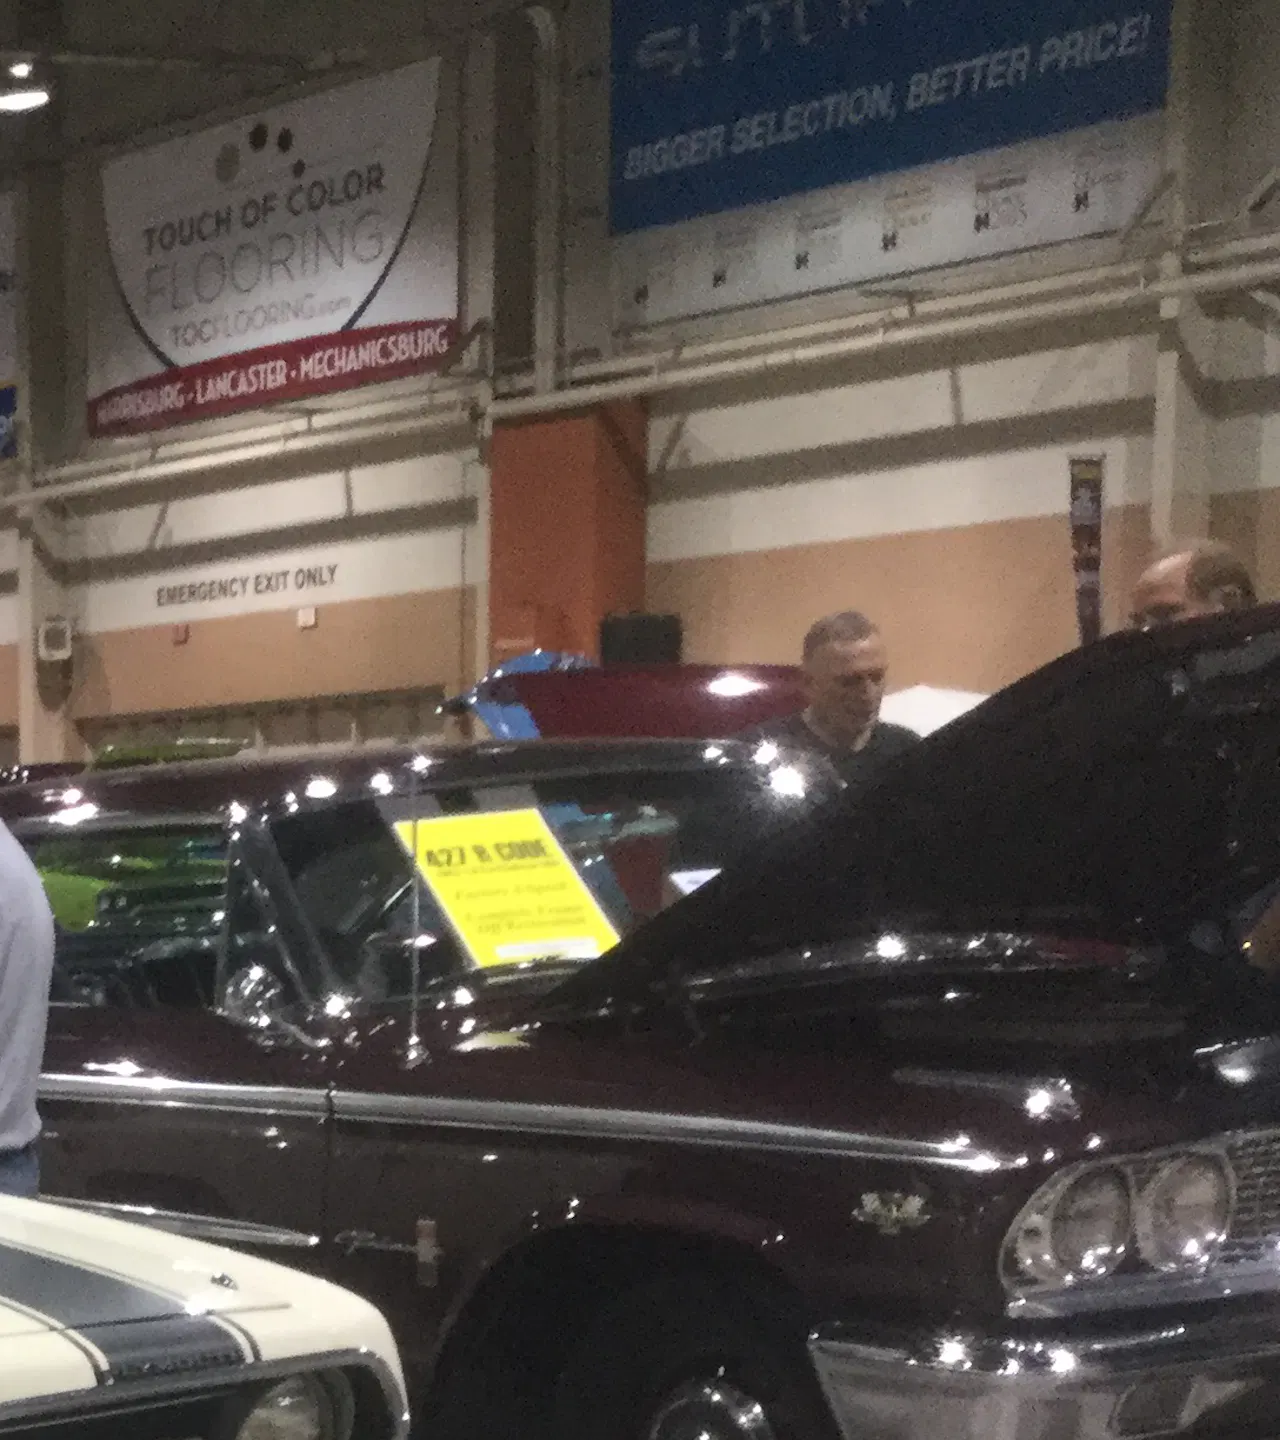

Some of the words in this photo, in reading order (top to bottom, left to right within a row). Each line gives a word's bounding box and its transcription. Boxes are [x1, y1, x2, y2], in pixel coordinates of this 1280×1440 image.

[622, 123, 727, 181] BIGGER
[729, 79, 897, 155] SELECTION,
[906, 44, 1028, 112] BETTER
[1038, 13, 1153, 74] PRICE!
[142, 205, 232, 256] TOUCH
[240, 193, 278, 228] OF
[286, 162, 386, 217] COLOR
[144, 210, 384, 315] FLOORING
[195, 359, 289, 405] LANCASTER
[299, 327, 450, 382] MECHANICSBURG
[157, 575, 249, 606] EMERGENCY
[253, 570, 290, 594] EXIT
[294, 564, 338, 590] ONLY
